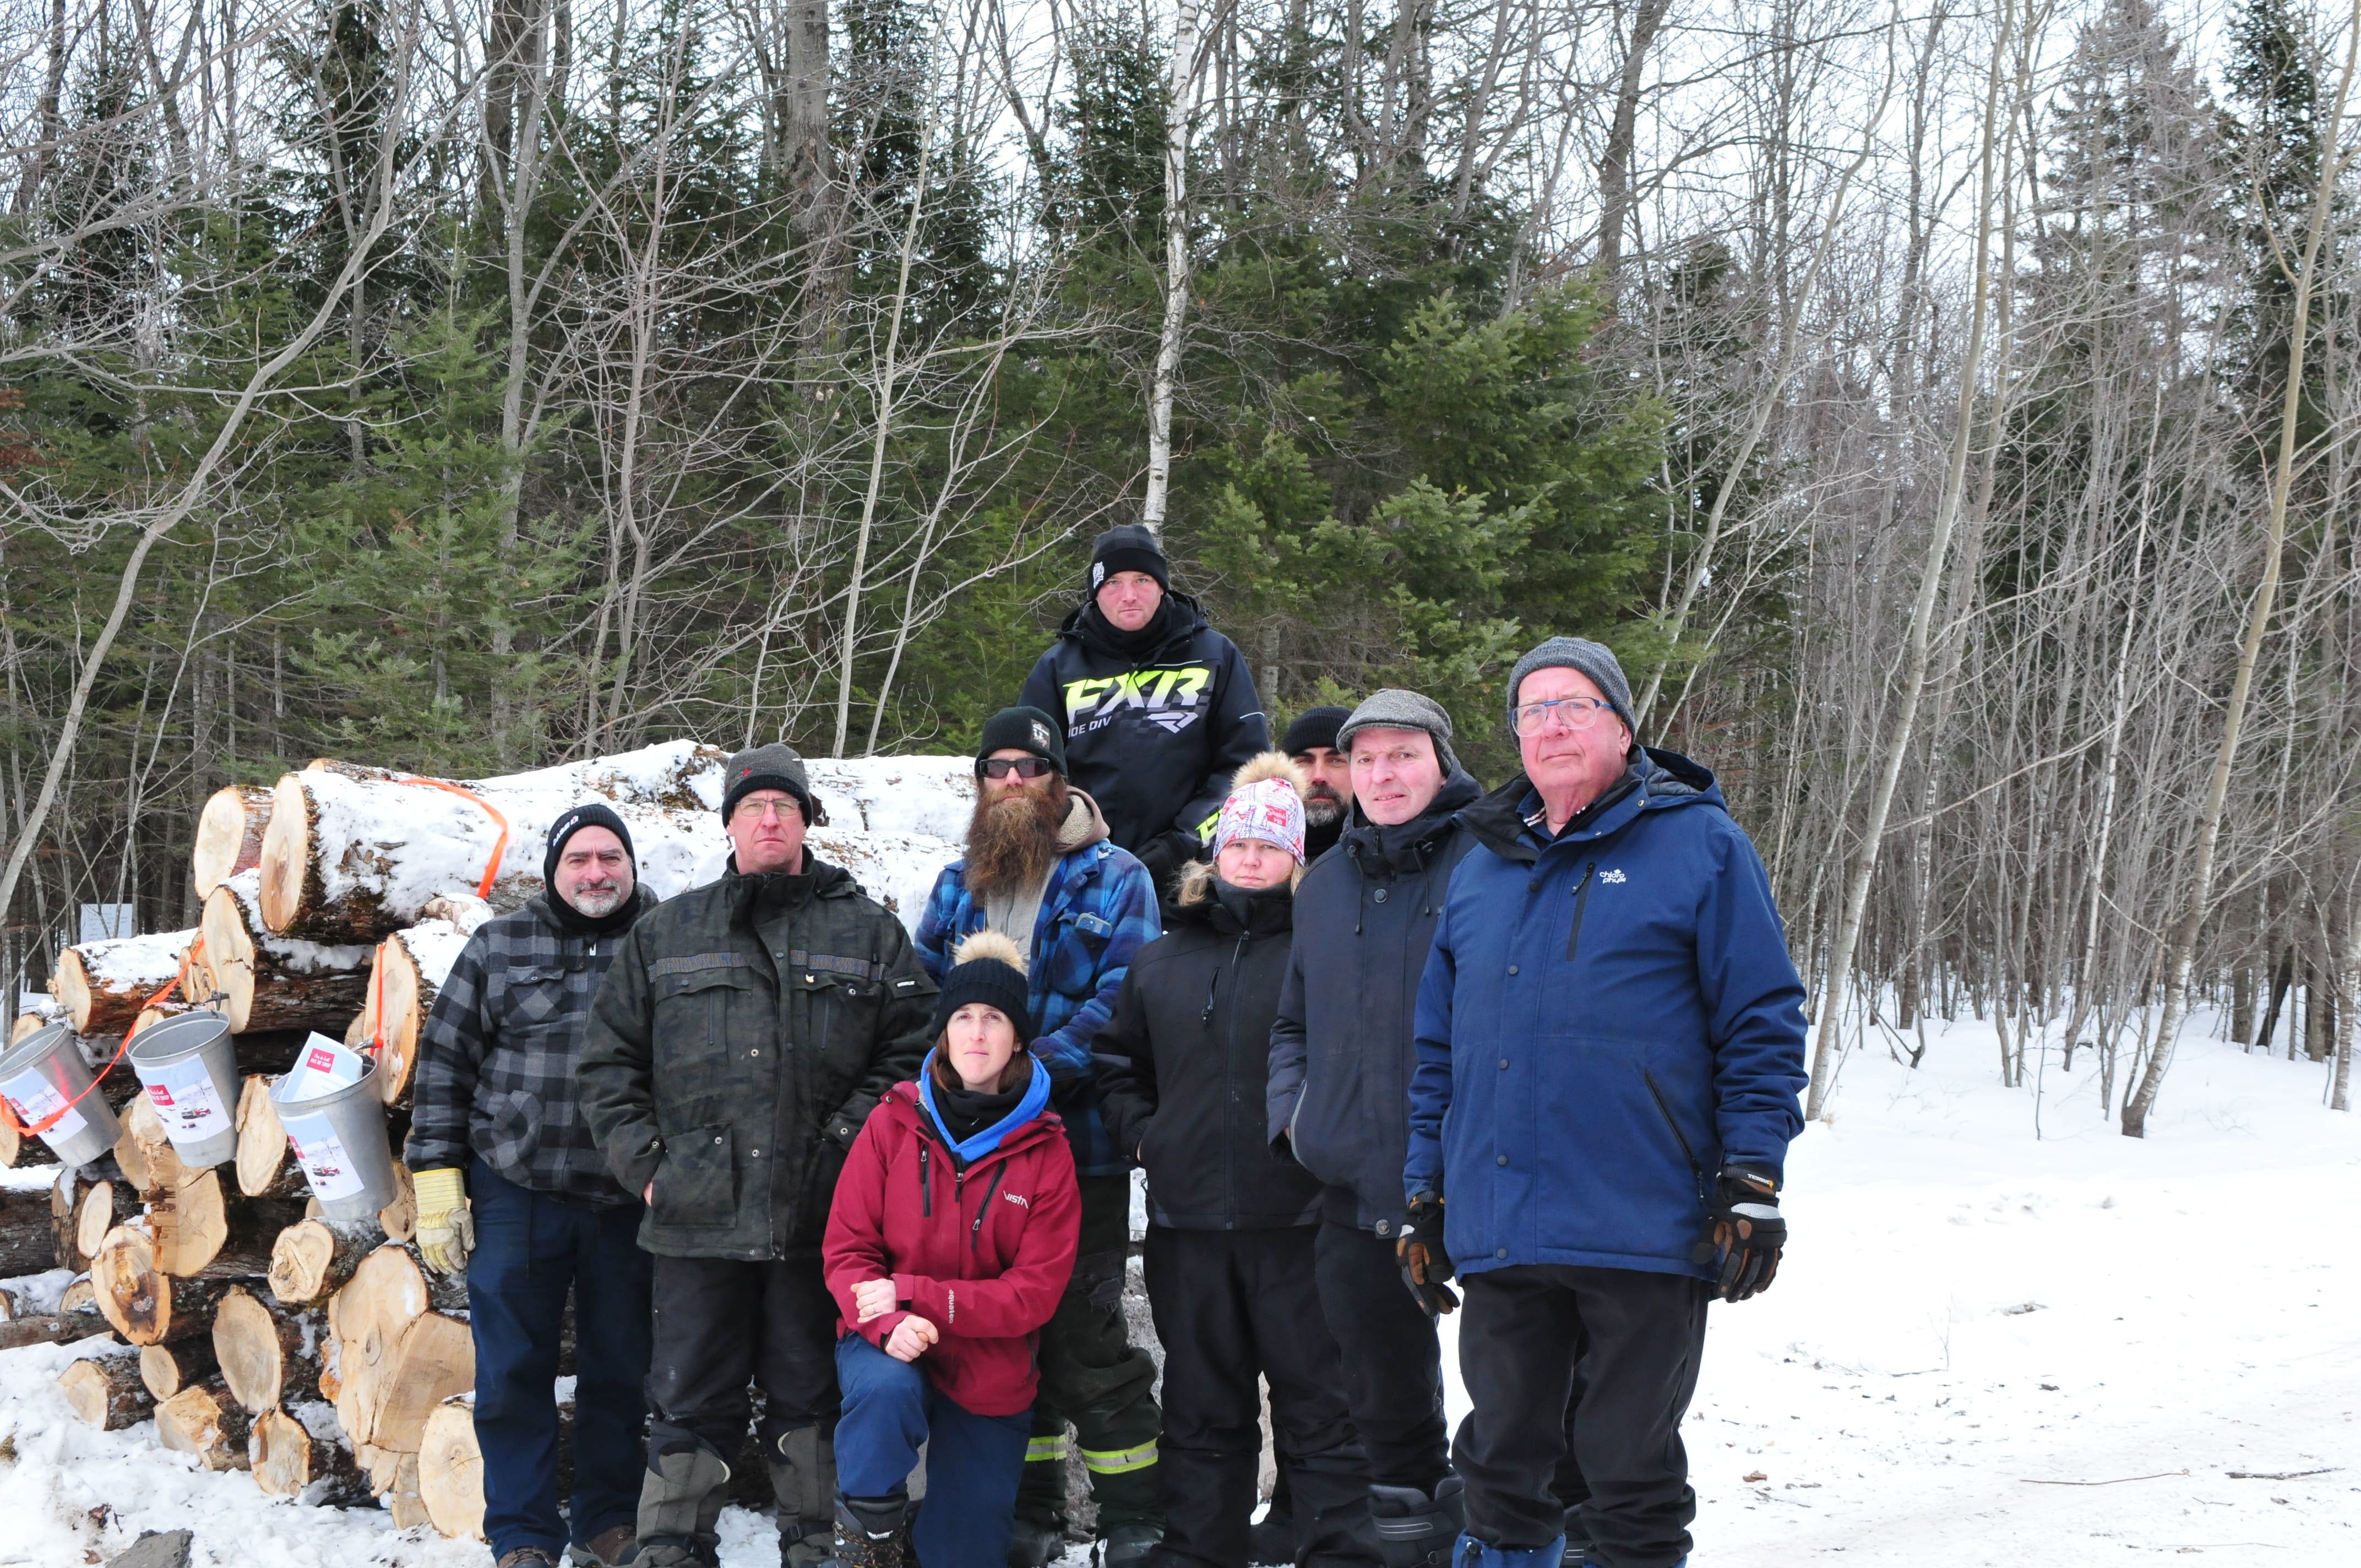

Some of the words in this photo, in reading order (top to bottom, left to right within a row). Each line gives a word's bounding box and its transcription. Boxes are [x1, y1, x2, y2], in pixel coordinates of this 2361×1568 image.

[1063, 668, 1210, 724] FXR
[1089, 716, 1112, 731] DIV
[553, 821, 570, 847] CASE
